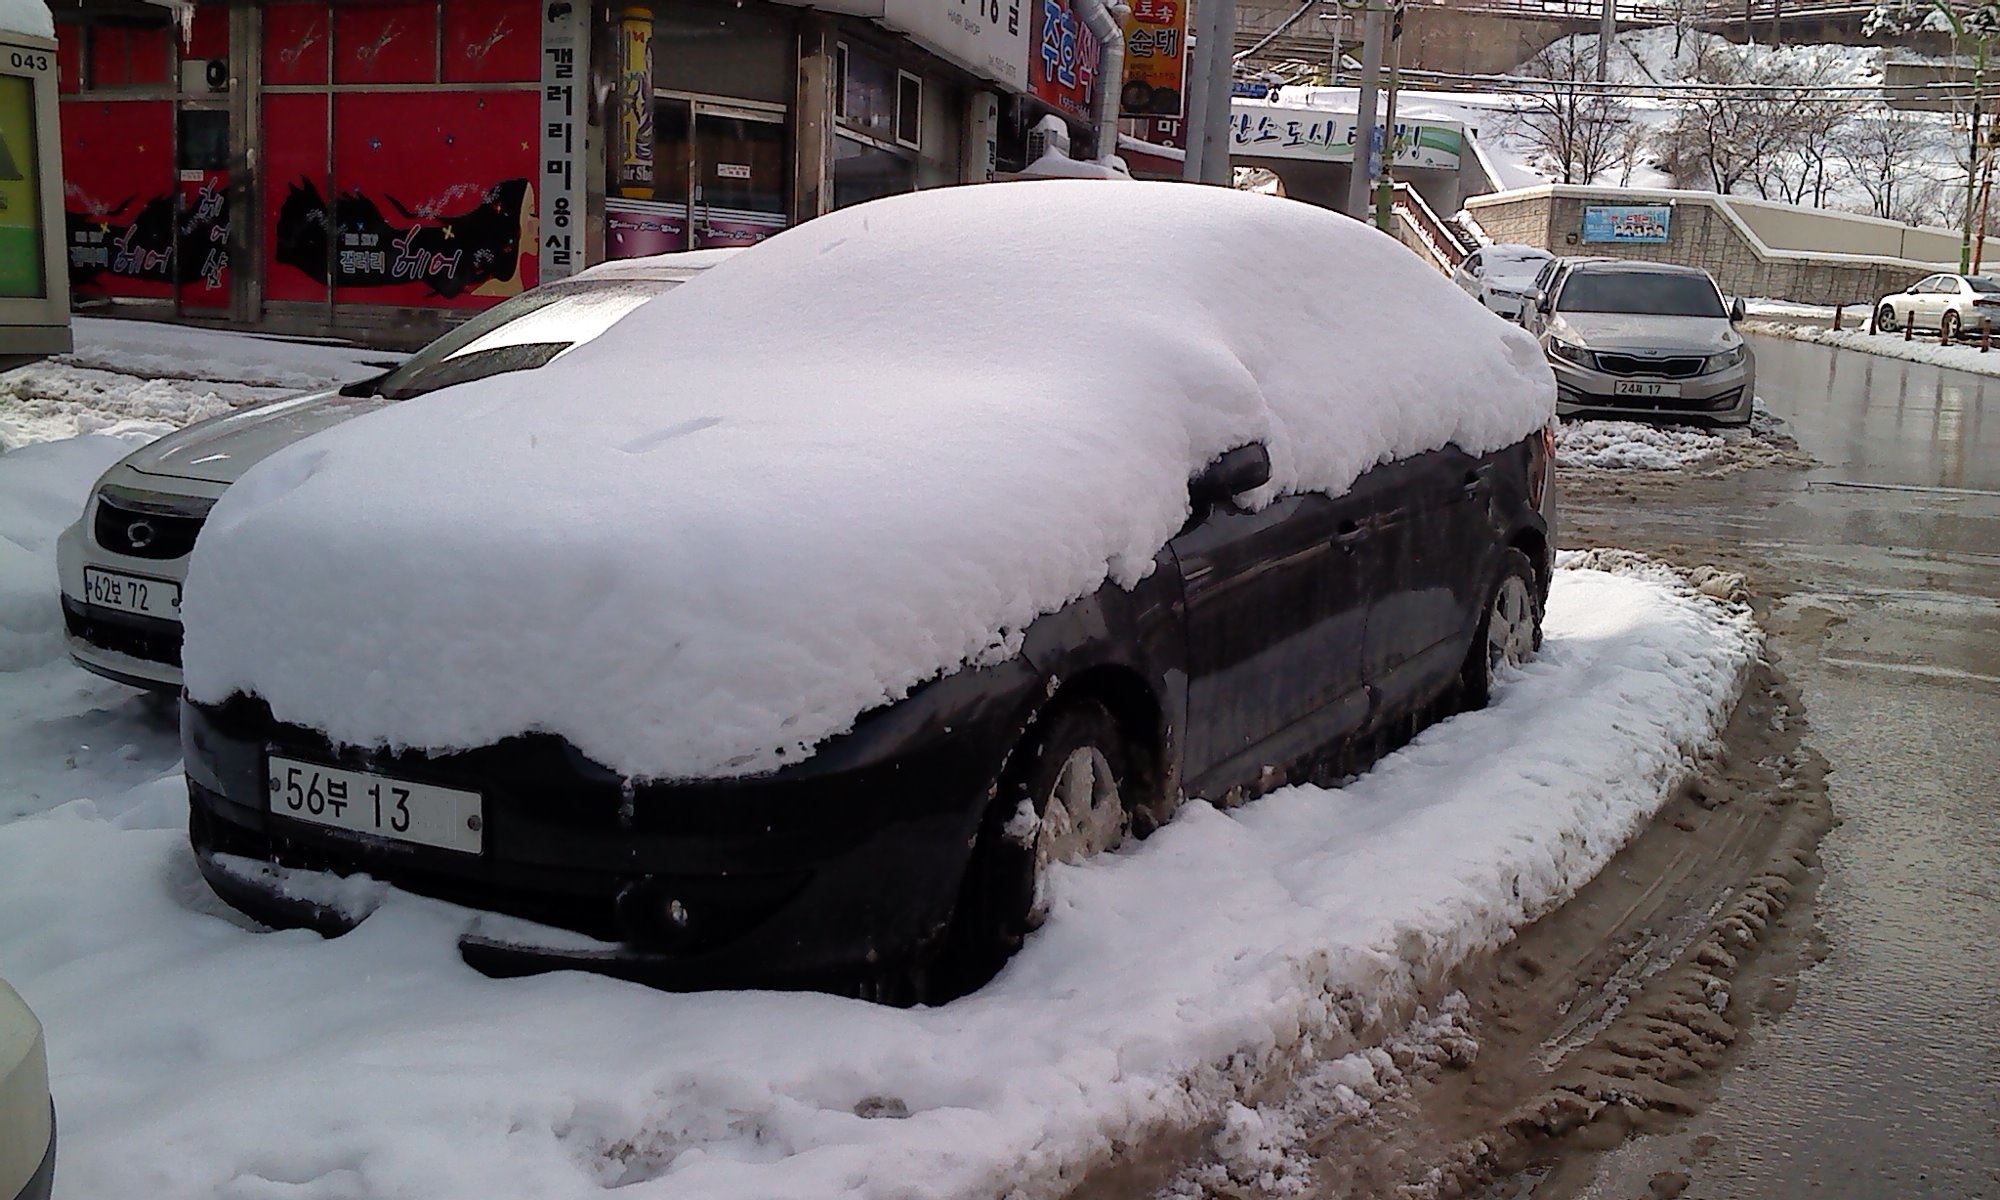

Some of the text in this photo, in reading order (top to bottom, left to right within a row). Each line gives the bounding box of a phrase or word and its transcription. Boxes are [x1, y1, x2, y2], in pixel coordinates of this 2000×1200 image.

[11, 53, 48, 71] 043
[1128, 28, 1178, 57] 순대
[545, 48, 573, 265] 갤러리미용실
[113, 224, 172, 274] 헤어
[340, 224, 462, 279] 갤러리 헤어
[1648, 385, 1661, 394] 17
[95, 576, 149, 610] 62보 72
[287, 768, 410, 832] 56부 13
